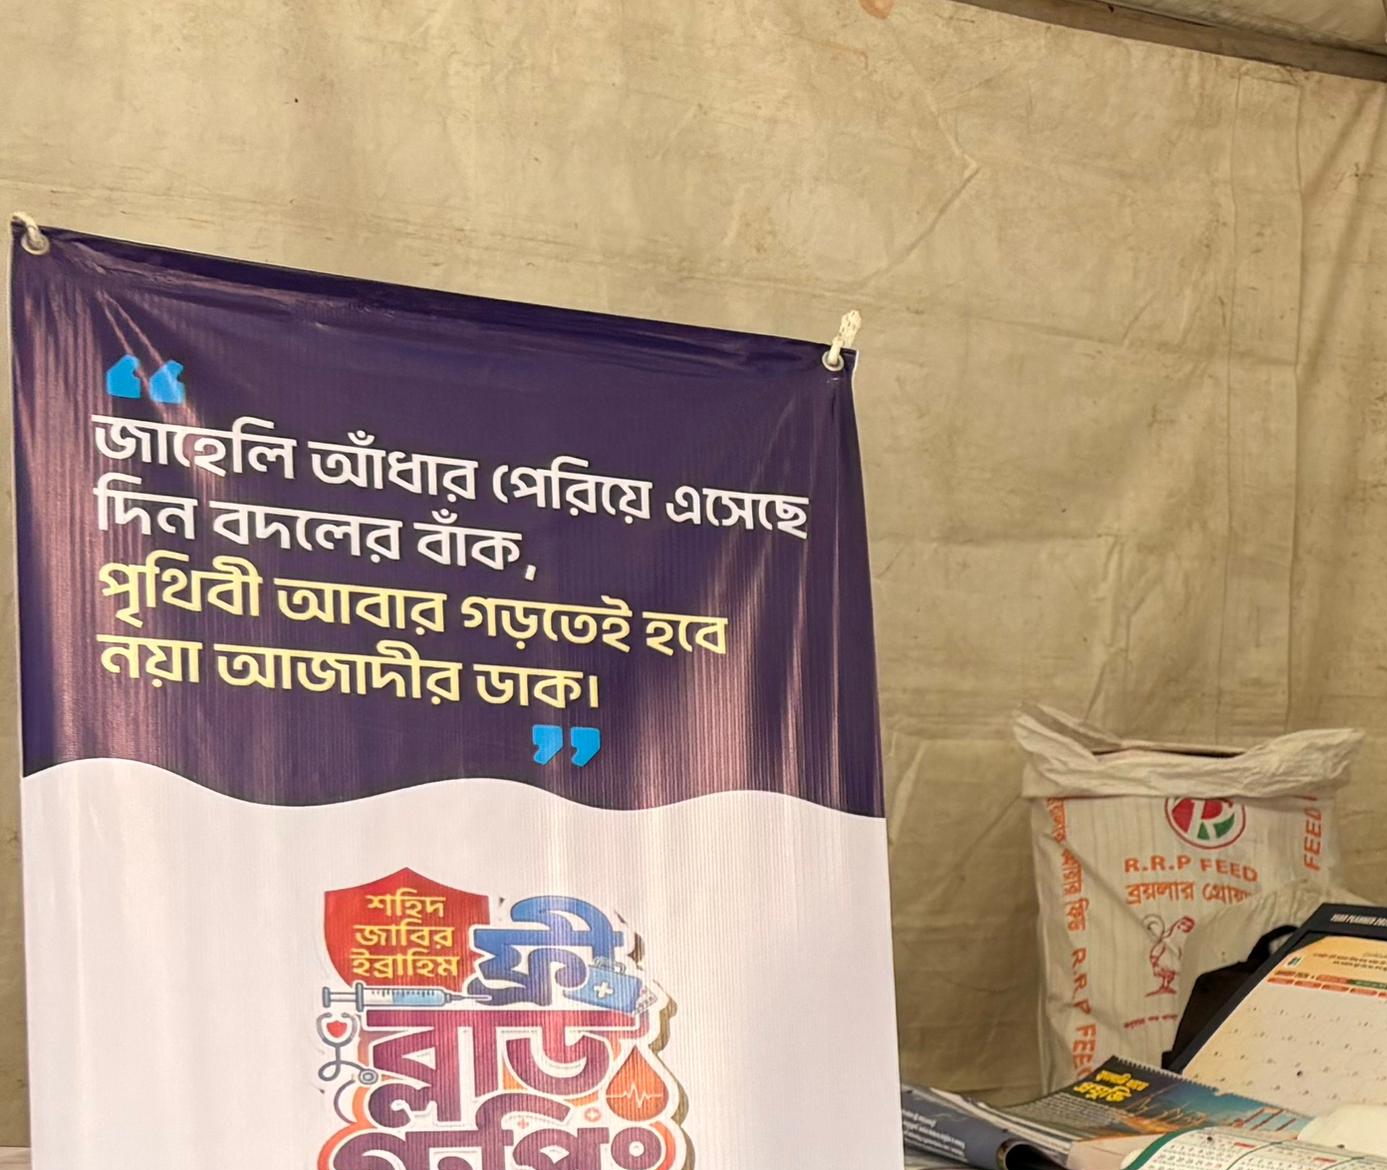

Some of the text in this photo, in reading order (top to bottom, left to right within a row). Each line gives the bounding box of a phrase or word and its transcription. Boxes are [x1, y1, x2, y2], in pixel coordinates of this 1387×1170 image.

[92, 414, 809, 539] জাহেলি আঁধার পেরিয়ে এসেছে
[93, 473, 537, 580] দিন বদলের বাঁক,
[98, 551, 727, 656] পৃথিবী আবার গড়তেই হবে
[97, 632, 600, 710] নয়া আজাদীর ডাক।
[366, 888, 446, 918] শহিদ
[1124, 855, 1258, 882] R.R.P FEED
[349, 950, 460, 979] ইব্রাহিম
[354, 919, 454, 951] জাবির
[465, 893, 625, 1006] ফ্রী
[364, 1008, 648, 1129] ব্লাড
